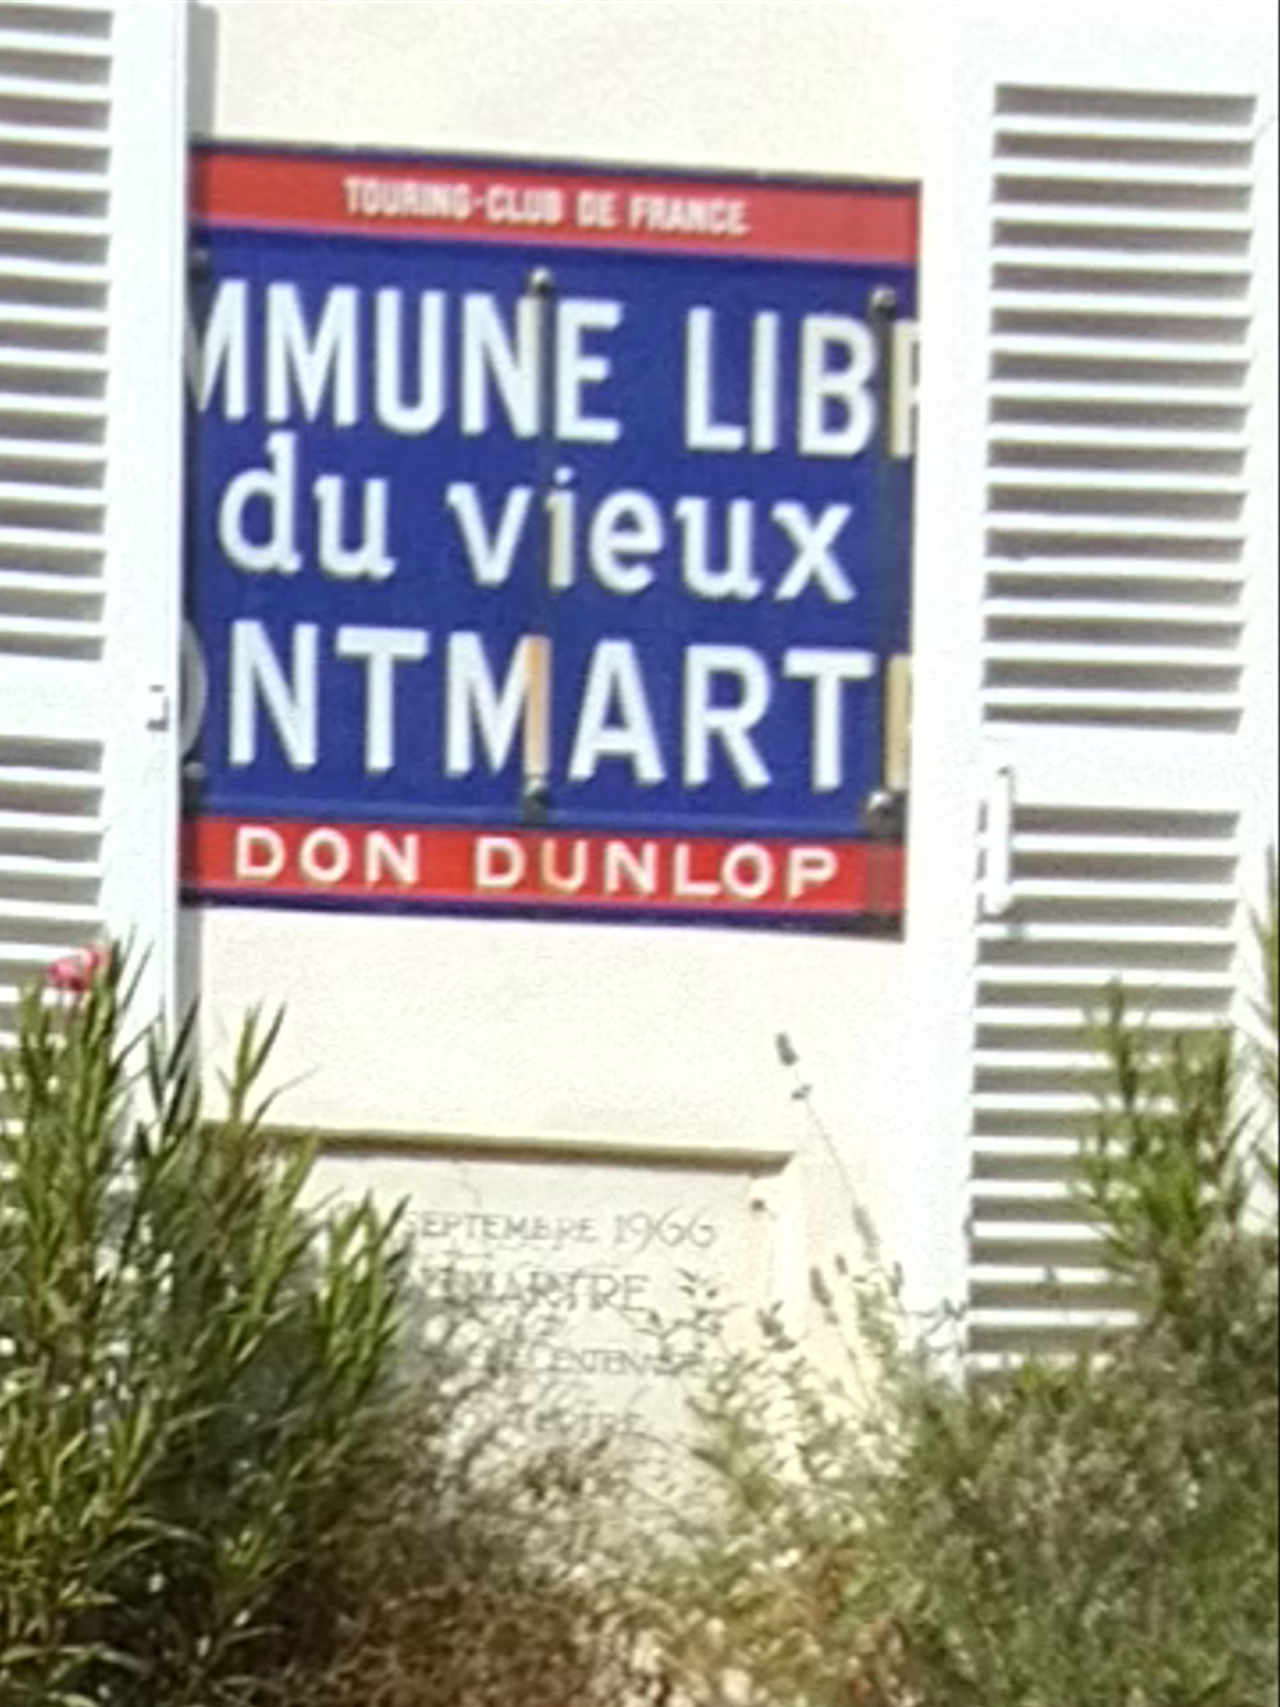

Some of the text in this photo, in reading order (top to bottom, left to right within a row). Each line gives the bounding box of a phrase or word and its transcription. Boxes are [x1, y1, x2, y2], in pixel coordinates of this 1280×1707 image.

[343, 176, 752, 236] TOURING-CLUB DE FRANCE
[218, 430, 856, 602] du vieux
[180, 618, 913, 792] NTMART
[235, 826, 840, 899] DON DUNLOP
